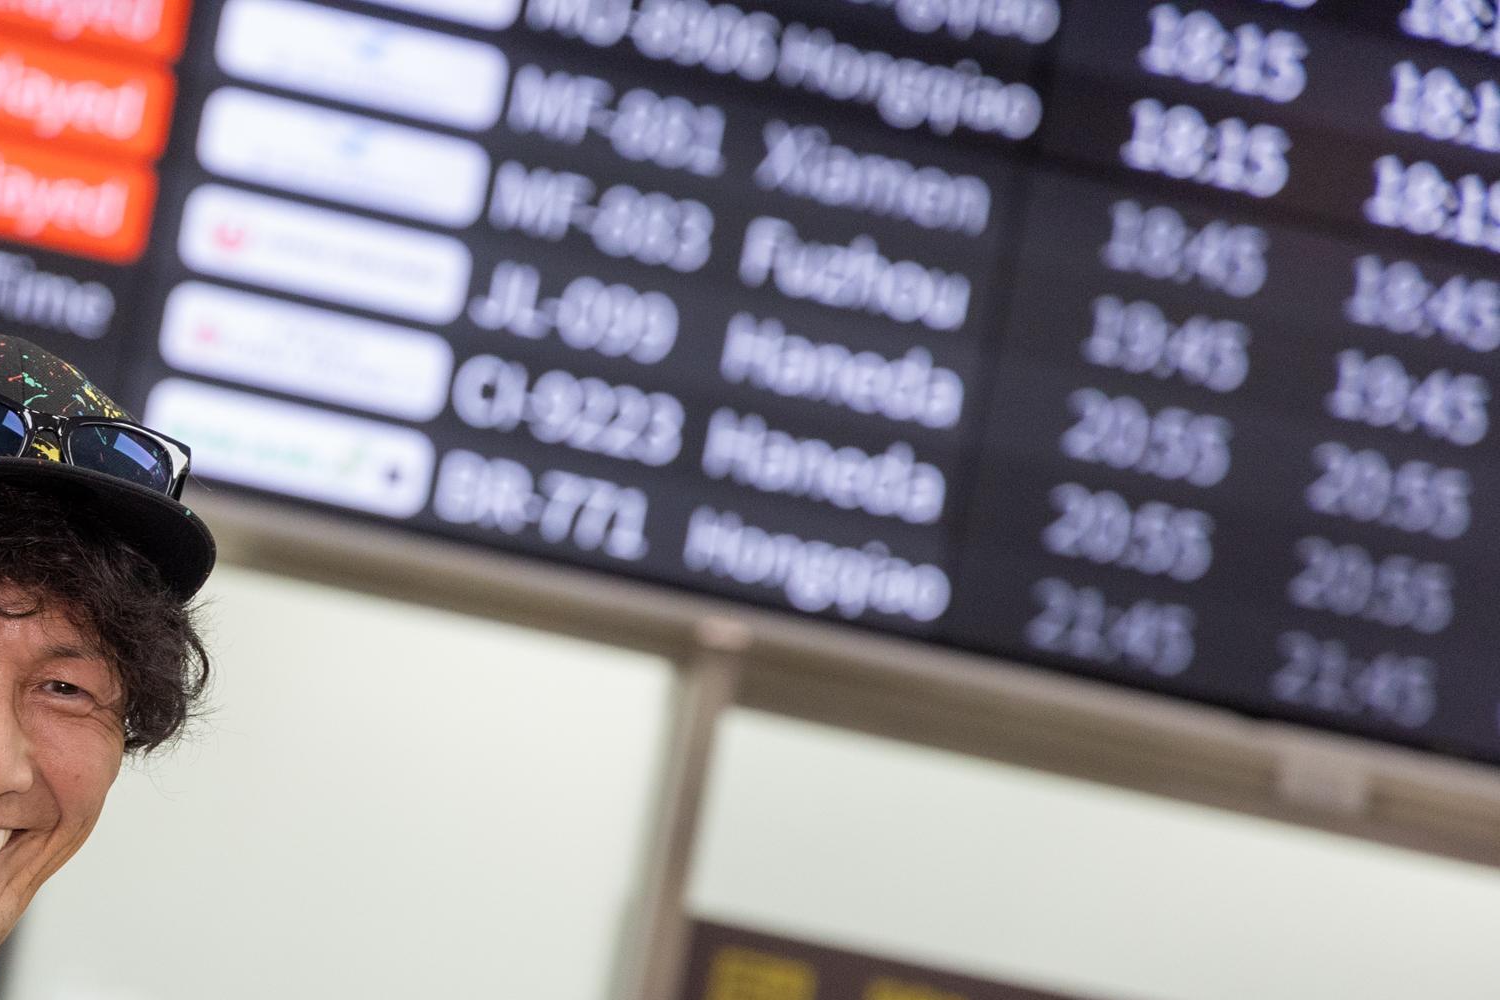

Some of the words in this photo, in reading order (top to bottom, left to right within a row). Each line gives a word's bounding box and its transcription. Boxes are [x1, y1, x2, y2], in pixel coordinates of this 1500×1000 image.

[507, 64, 726, 177] MF-881
[753, 119, 991, 235] Xiamen
[1103, 200, 1268, 297] 18:45
[776, 22, 1043, 139] Hongqiao
[1120, 98, 1292, 197] 18:15
[1363, 154, 1500, 249] 18:1
[1138, 4, 1308, 101] 18:15
[1381, 60, 1500, 152] 18:1
[468, 262, 679, 364] JL-099
[719, 313, 963, 429] Haneda
[1062, 388, 1233, 487] 20:55
[1307, 442, 1473, 539] 20:55
[488, 160, 714, 272] MF-883
[739, 216, 971, 330] Fuzhou
[1082, 295, 1250, 392] 19:45
[1325, 350, 1489, 446] 19:45
[433, 449, 648, 560] BR-771
[684, 506, 951, 622] Hongqiao
[1025, 577, 1197, 677] 21:45
[1272, 632, 1437, 729] 21:45
[452, 354, 685, 465] CI-9223
[702, 408, 946, 524] Haneda
[1042, 482, 1214, 581] 20:55
[1288, 536, 1455, 634] 20:55
